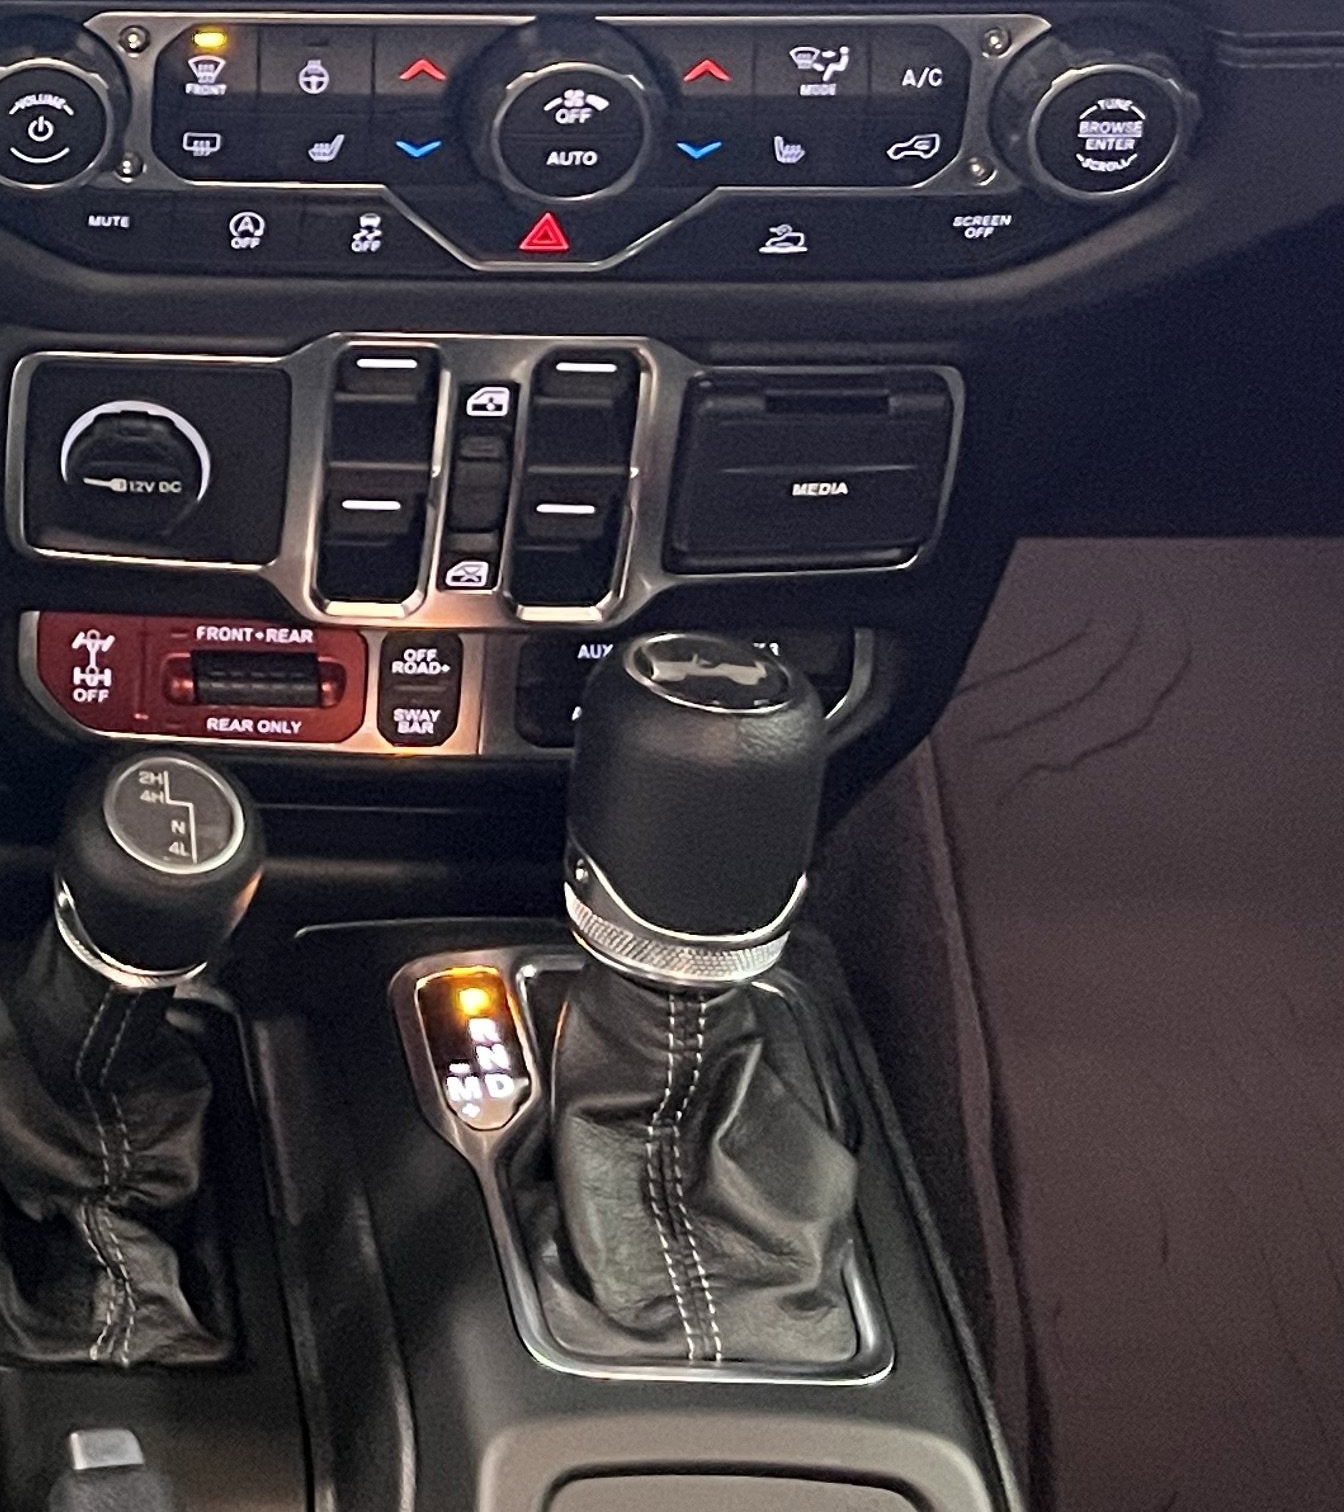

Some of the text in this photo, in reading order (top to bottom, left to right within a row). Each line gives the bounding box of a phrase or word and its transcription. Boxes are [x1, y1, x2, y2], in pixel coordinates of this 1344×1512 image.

[902, 68, 943, 88] A/C
[185, 82, 226, 96] FRONT
[14, 92, 65, 111] VOLUME
[1098, 98, 1134, 112] TUNE
[555, 108, 592, 125] OFF
[1079, 121, 1143, 135] BROWSE
[1085, 138, 1135, 152] ENTER
[546, 150, 598, 167] AUTO
[88, 215, 130, 228] MUTE
[953, 214, 1012, 228] SCREEN
[964, 227, 993, 239] OFF
[230, 237, 261, 250] OFF
[351, 238, 382, 253] OFF
[128, 480, 182, 493] 12V DC
[792, 481, 849, 496] MEDIA
[404, 648, 437, 661] OFF
[73, 688, 110, 703] OFF
[393, 709, 441, 723] SWAY
[207, 718, 302, 735] REAR ONLY
[398, 721, 434, 734] BAR
[139, 771, 162, 785] 2H
[140, 790, 164, 805] 4H
[171, 821, 185, 834] N
[168, 841, 188, 856] 4L
[476, 1044, 510, 1071] N
[446, 1076, 482, 1102] M
[485, 1073, 515, 1098] D
